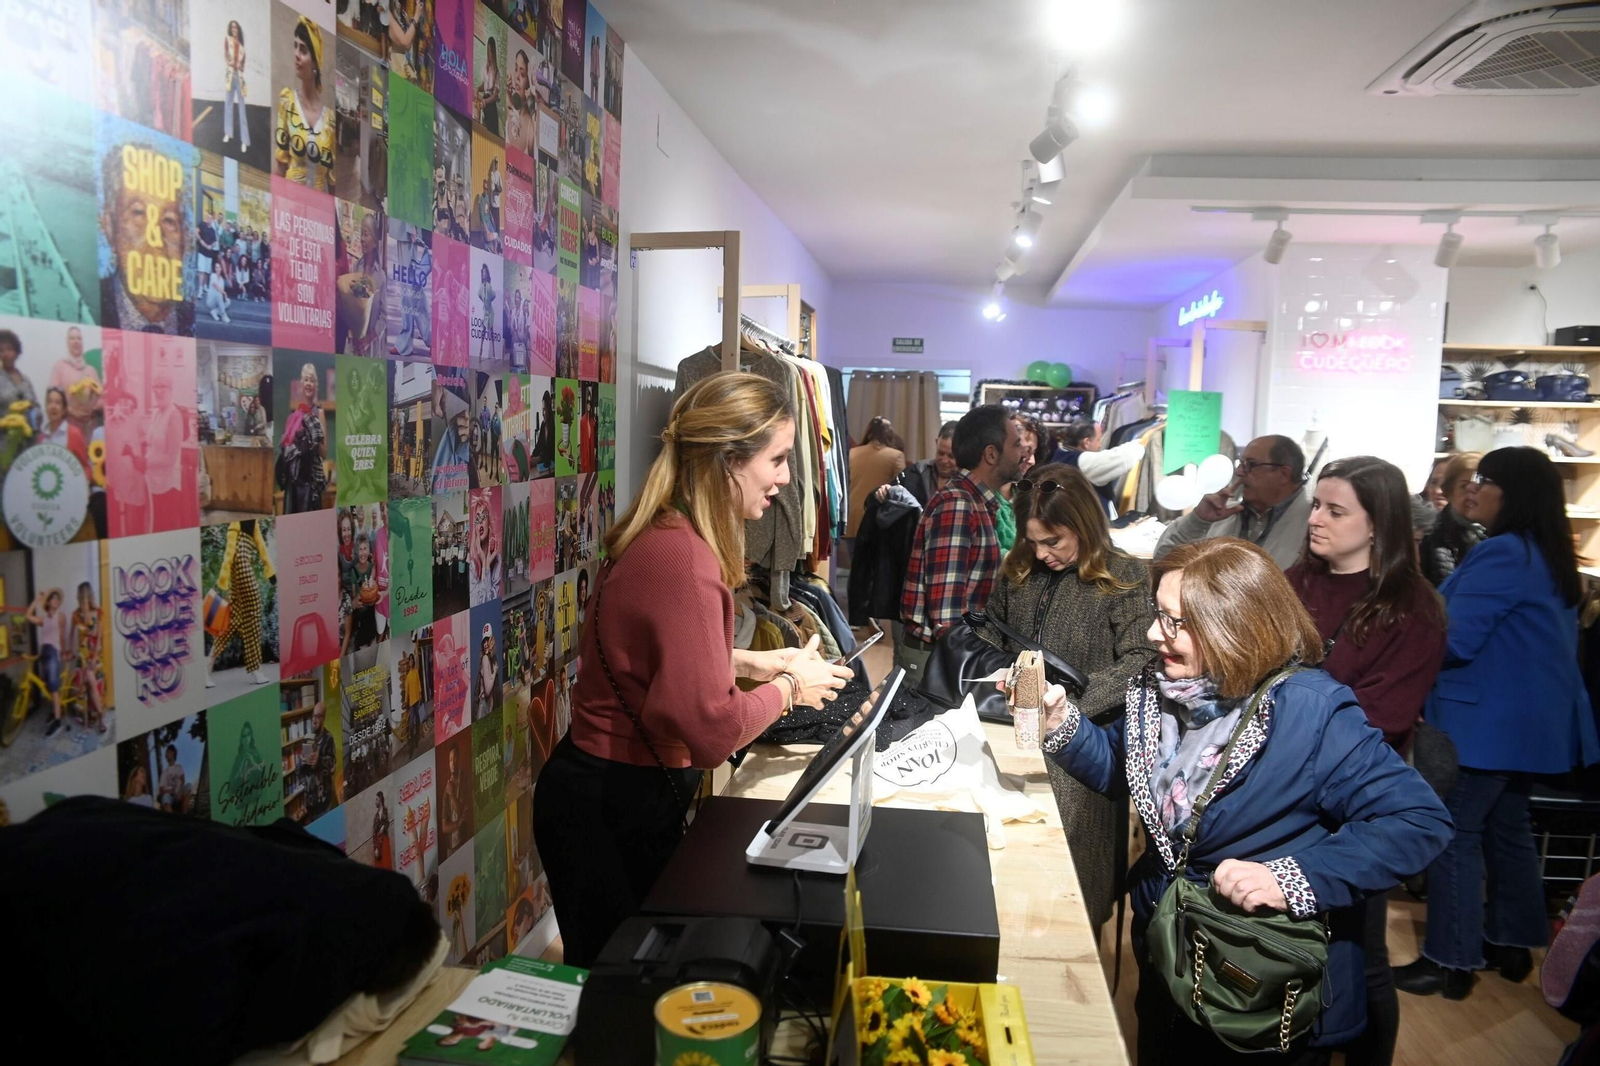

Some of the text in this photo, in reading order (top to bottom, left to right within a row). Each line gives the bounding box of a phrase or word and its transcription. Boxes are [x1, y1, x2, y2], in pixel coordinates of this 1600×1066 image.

[441, 44, 468, 77] HOLA
[122, 145, 183, 202] SHOP
[146, 204, 163, 247] &
[274, 209, 334, 246] LAS PERSONAS
[289, 237, 322, 263] DE ESTA
[504, 235, 532, 254] CUIDADOS
[127, 250, 183, 301] CARE
[290, 259, 319, 284] TIENDA
[393, 263, 427, 288] HELLO
[297, 283, 315, 304] SON
[534, 284, 550, 318] LOVE
[278, 301, 333, 329] VOLUNTARIAS
[532, 308, 556, 346] ALL YOU
[535, 330, 552, 363] NEED
[1299, 354, 1412, 372] CUDEQUERO
[345, 433, 382, 445] CELEBRA
[351, 446, 377, 459] QUIEN
[13, 443, 82, 478] VOLUNTARIADO
[352, 459, 374, 471] ERES
[443, 477, 468, 489] futuro
[10, 513, 80, 548] VOLUNTEERS
[295, 553, 323, 567] SECOND
[113, 554, 197, 609] LOOK
[395, 585, 428, 606] Desde
[115, 594, 195, 642] CUDE
[403, 604, 419, 618] 1992
[124, 628, 190, 671] QUE
[137, 657, 184, 703] RO
[447, 664, 458, 677] lot
[461, 657, 469, 670] of
[351, 690, 362, 703] DEL
[349, 718, 387, 746] DESDE 1992
[906, 739, 949, 753] CHARITY
[474, 743, 502, 776] RESPIRA,
[880, 751, 906, 768] SHOP
[896, 747, 943, 779] JOAN
[217, 763, 279, 815] Sostenible
[398, 767, 432, 803] REDUCE
[479, 764, 498, 793] VERDE
[477, 996, 572, 1021] VOLUNTARIADO
[520, 1016, 565, 1031] Conoce
